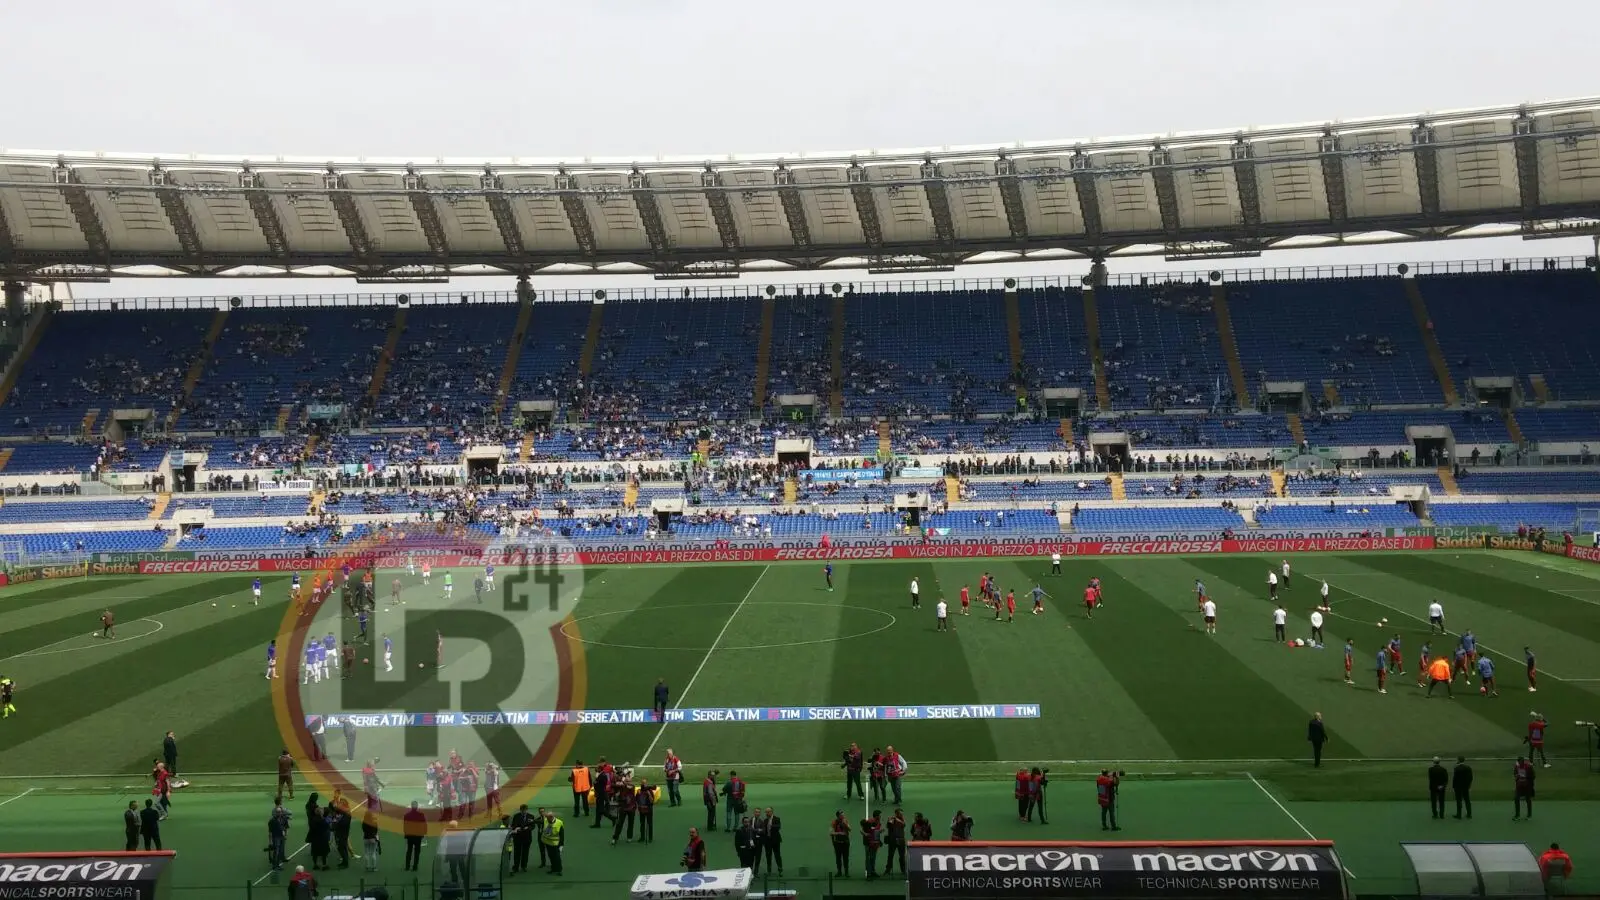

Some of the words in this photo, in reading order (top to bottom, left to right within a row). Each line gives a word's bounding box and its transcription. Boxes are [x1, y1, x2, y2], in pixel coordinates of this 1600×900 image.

[909, 547, 948, 557] VIAGGI
[951, 547, 962, 556] IN
[976, 546, 988, 555] AL
[992, 545, 1034, 555] PREZZO
[1038, 544, 1063, 554] BASE
[1067, 544, 1078, 554] DI
[1101, 541, 1222, 554] FRECCIAROSSA
[1238, 541, 1278, 551] VIAGGI
[1282, 541, 1293, 550] IN
[1308, 540, 1321, 550] AL
[1325, 540, 1369, 550] PREZZO
[1372, 539, 1398, 549] BASE
[1403, 539, 1414, 549] DI
[458, 553, 575, 566] FRECCIAROSSA
[590, 553, 627, 562] VIAGGI
[630, 554, 642, 562] IN
[655, 553, 668, 561] AL
[671, 551, 712, 560] PREZZO
[715, 551, 740, 560] BASE
[744, 551, 754, 560] DI
[776, 547, 893, 559] FRECCIAROSSA
[143, 561, 259, 573] FRECCIAROSSA
[274, 560, 311, 569] VIAGGI
[315, 560, 326, 568] IN
[348, 714, 379, 726] SERIE
[391, 714, 415, 725] TIM
[435, 714, 454, 724] TIM
[462, 713, 493, 724] SERIE
[505, 712, 529, 723] TIM
[549, 712, 568, 722] TIM
[577, 711, 609, 723] SERIE
[620, 710, 644, 722] TIM
[664, 710, 684, 721] TIM
[692, 709, 725, 721] SERIE
[736, 709, 760, 720] TIM
[780, 709, 800, 719] TIM
[809, 708, 842, 720] SERIE
[851, 707, 877, 719] TIM
[897, 708, 918, 718] TIM
[926, 706, 960, 718] SERIE
[970, 706, 995, 717] TIM
[1016, 706, 1036, 716] TIM
[922, 850, 1100, 871] macron
[1132, 850, 1318, 871] macron
